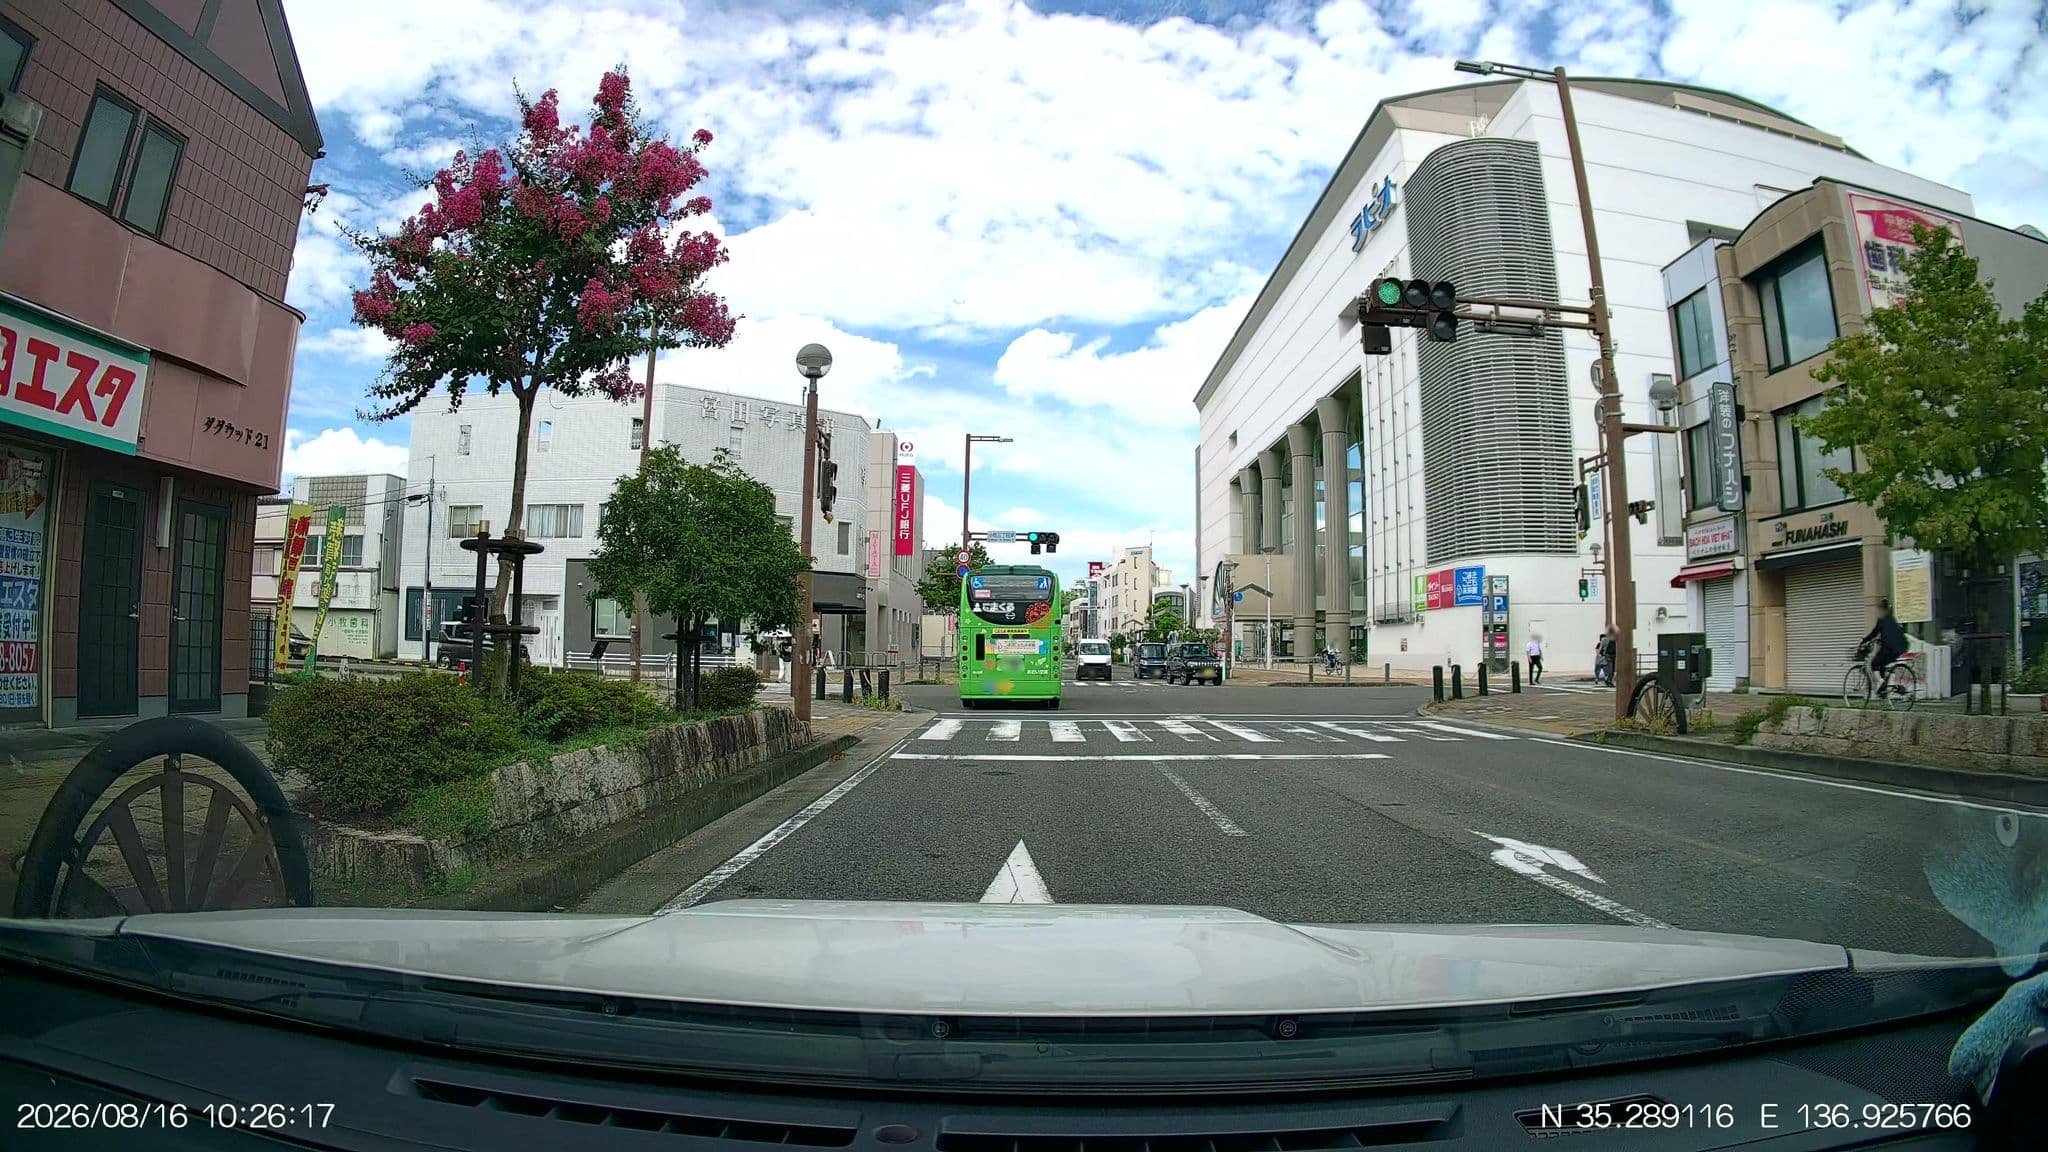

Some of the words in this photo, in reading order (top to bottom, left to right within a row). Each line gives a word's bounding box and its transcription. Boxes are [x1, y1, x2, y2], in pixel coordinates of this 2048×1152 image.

[1351, 174, 1391, 252] ラピオ
[255, 432, 268, 449] 21
[1718, 389, 1739, 503] 洋装のフナハシ
[900, 472, 911, 540] 三菱UFJ銀行
[1786, 520, 1848, 544] FUNAHASHI
[960, 553, 968, 561] 40
[1495, 596, 1504, 610] P
